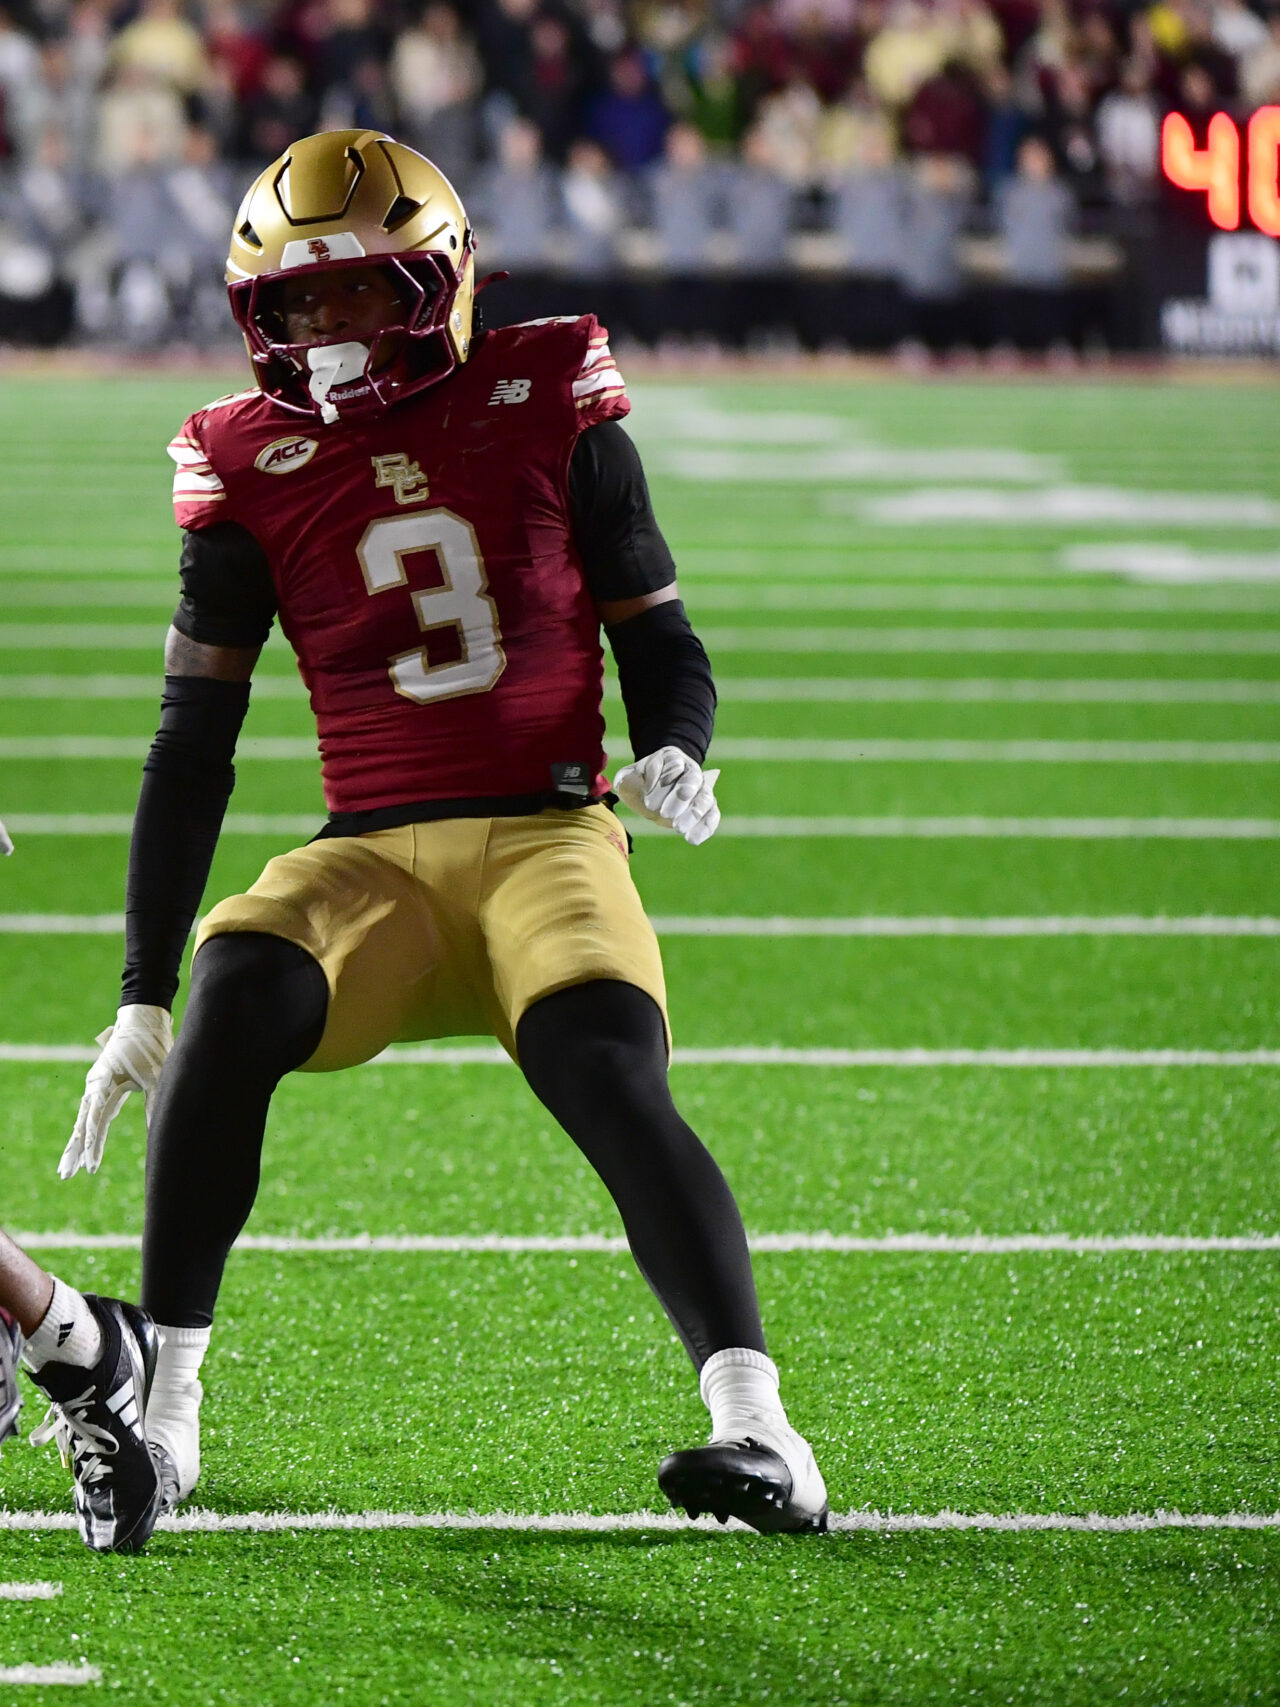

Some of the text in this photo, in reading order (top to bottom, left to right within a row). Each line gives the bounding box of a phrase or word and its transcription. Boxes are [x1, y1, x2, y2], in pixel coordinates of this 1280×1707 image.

[264, 439, 311, 467] ACC
[371, 453, 430, 504] BC
[356, 507, 507, 704] 3
